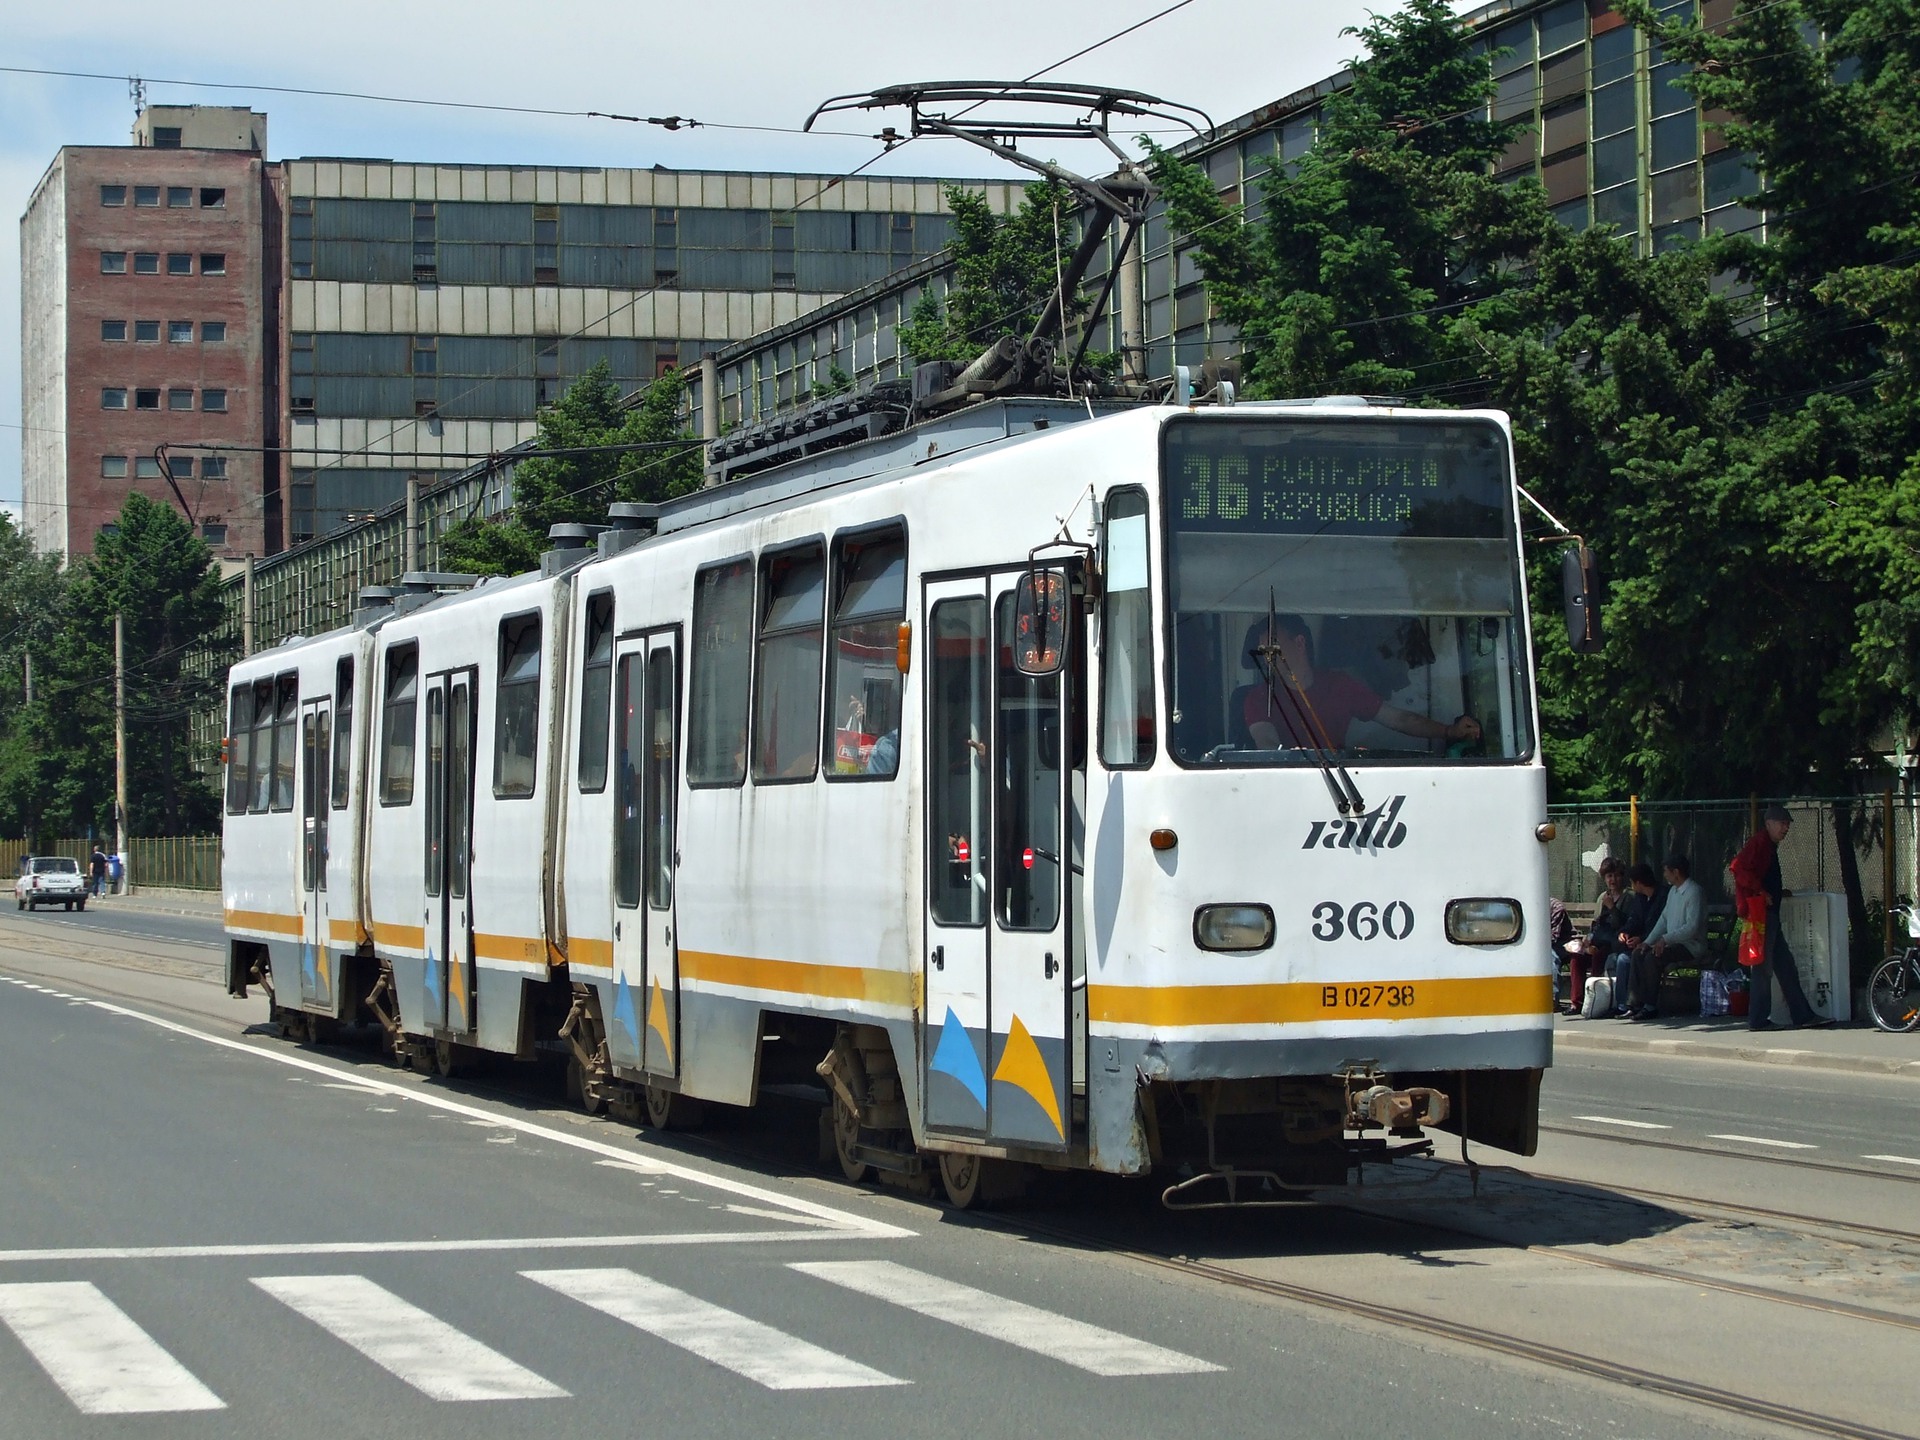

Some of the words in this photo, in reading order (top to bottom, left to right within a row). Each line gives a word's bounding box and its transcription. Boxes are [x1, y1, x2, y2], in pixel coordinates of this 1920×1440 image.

[1182, 454, 1249, 520] 36
[1312, 900, 1415, 942] 360
[1322, 986, 1338, 1007] B
[1345, 985, 1415, 1007] 02738
